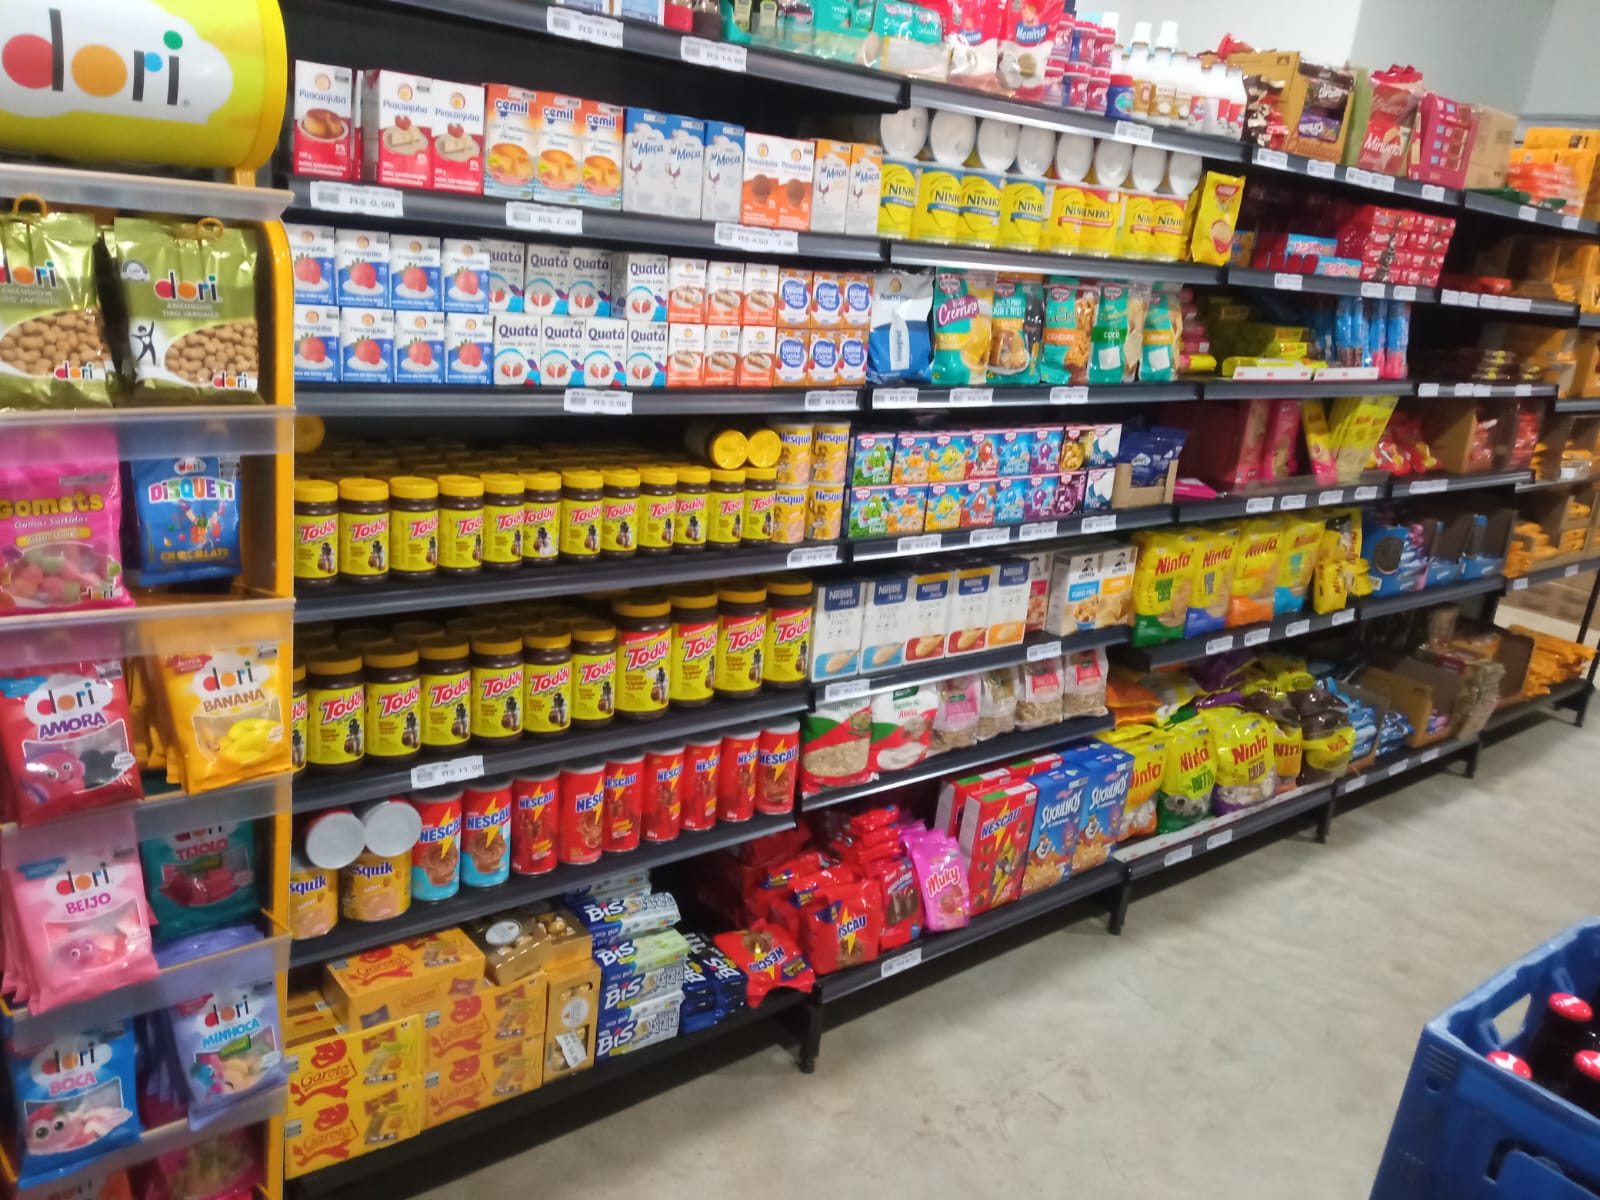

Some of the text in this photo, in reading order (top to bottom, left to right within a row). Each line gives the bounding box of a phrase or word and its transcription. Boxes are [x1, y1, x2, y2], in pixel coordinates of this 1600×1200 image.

[2, 8, 183, 105] dori
[495, 99, 528, 114] cemil
[543, 107, 574, 121] cemil
[586, 114, 616, 128] cemil
[530, 254, 568, 269] Quatá
[573, 256, 609, 271] Quatá
[630, 262, 666, 276] Quatá
[154, 270, 217, 303] dori
[938, 300, 978, 326] Cremoso
[498, 323, 538, 339] Quatá
[544, 323, 583, 340] Quatá
[588, 327, 625, 341] Quatá
[631, 328, 666, 343] Quatá
[54, 361, 94, 380] dori
[212, 371, 248, 389] dori
[817, 431, 848, 445] Nesqui
[604, 502, 636, 522] Toddy
[1202, 547, 1232, 568] Ninfa
[1245, 535, 1278, 559] Ninfa
[1156, 553, 1190, 576] Ninfa
[625, 639, 670, 672] Toddy
[203, 659, 254, 692] dori
[480, 670, 523, 700] Toddy
[36, 681, 95, 716] dori
[202, 688, 266, 713] BANANA
[39, 711, 107, 738] AMORA
[519, 790, 555, 809] NESCAU
[980, 806, 1021, 840] NESCAU
[56, 862, 110, 896] dori
[926, 866, 960, 898] Muky
[66, 891, 112, 915] BEIJO
[204, 994, 249, 1027] dori
[202, 1018, 260, 1049] MINHOCA
[42, 1042, 95, 1075] dori
[49, 1071, 97, 1096] BOCA
[300, 1063, 350, 1089] Garoto
